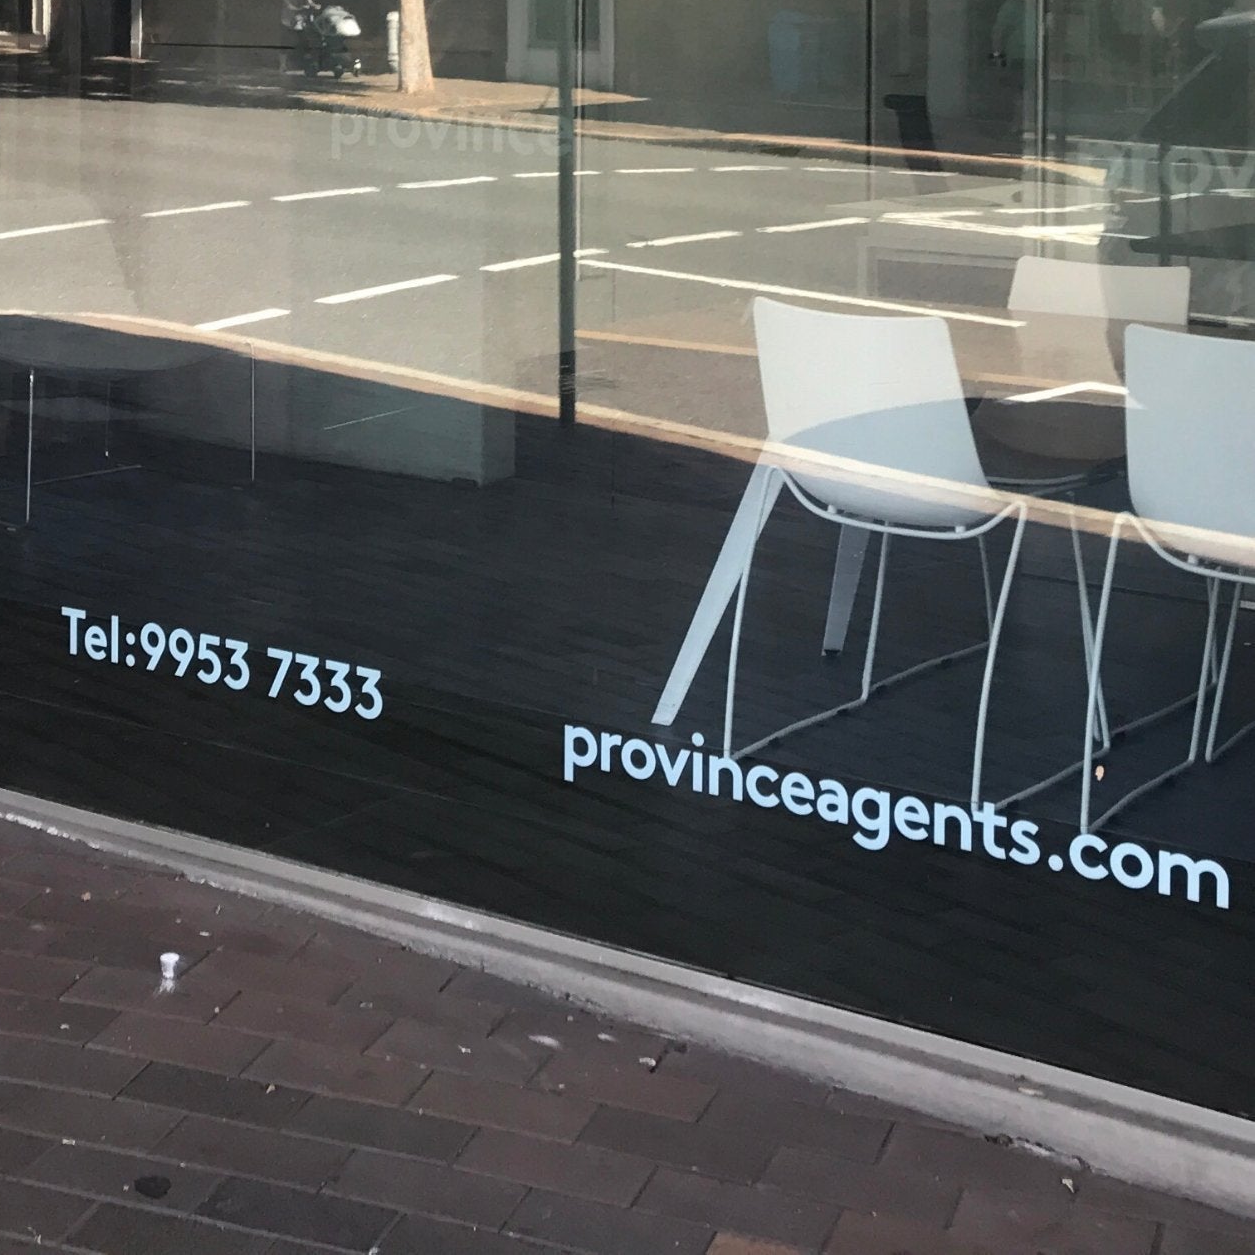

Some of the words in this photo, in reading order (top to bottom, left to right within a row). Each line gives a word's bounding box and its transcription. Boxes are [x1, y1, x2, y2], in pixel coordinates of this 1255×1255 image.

[61, 606, 251, 691] Tel:9953
[267, 646, 384, 720] 7333
[563, 723, 1231, 910] provinceagents.com
